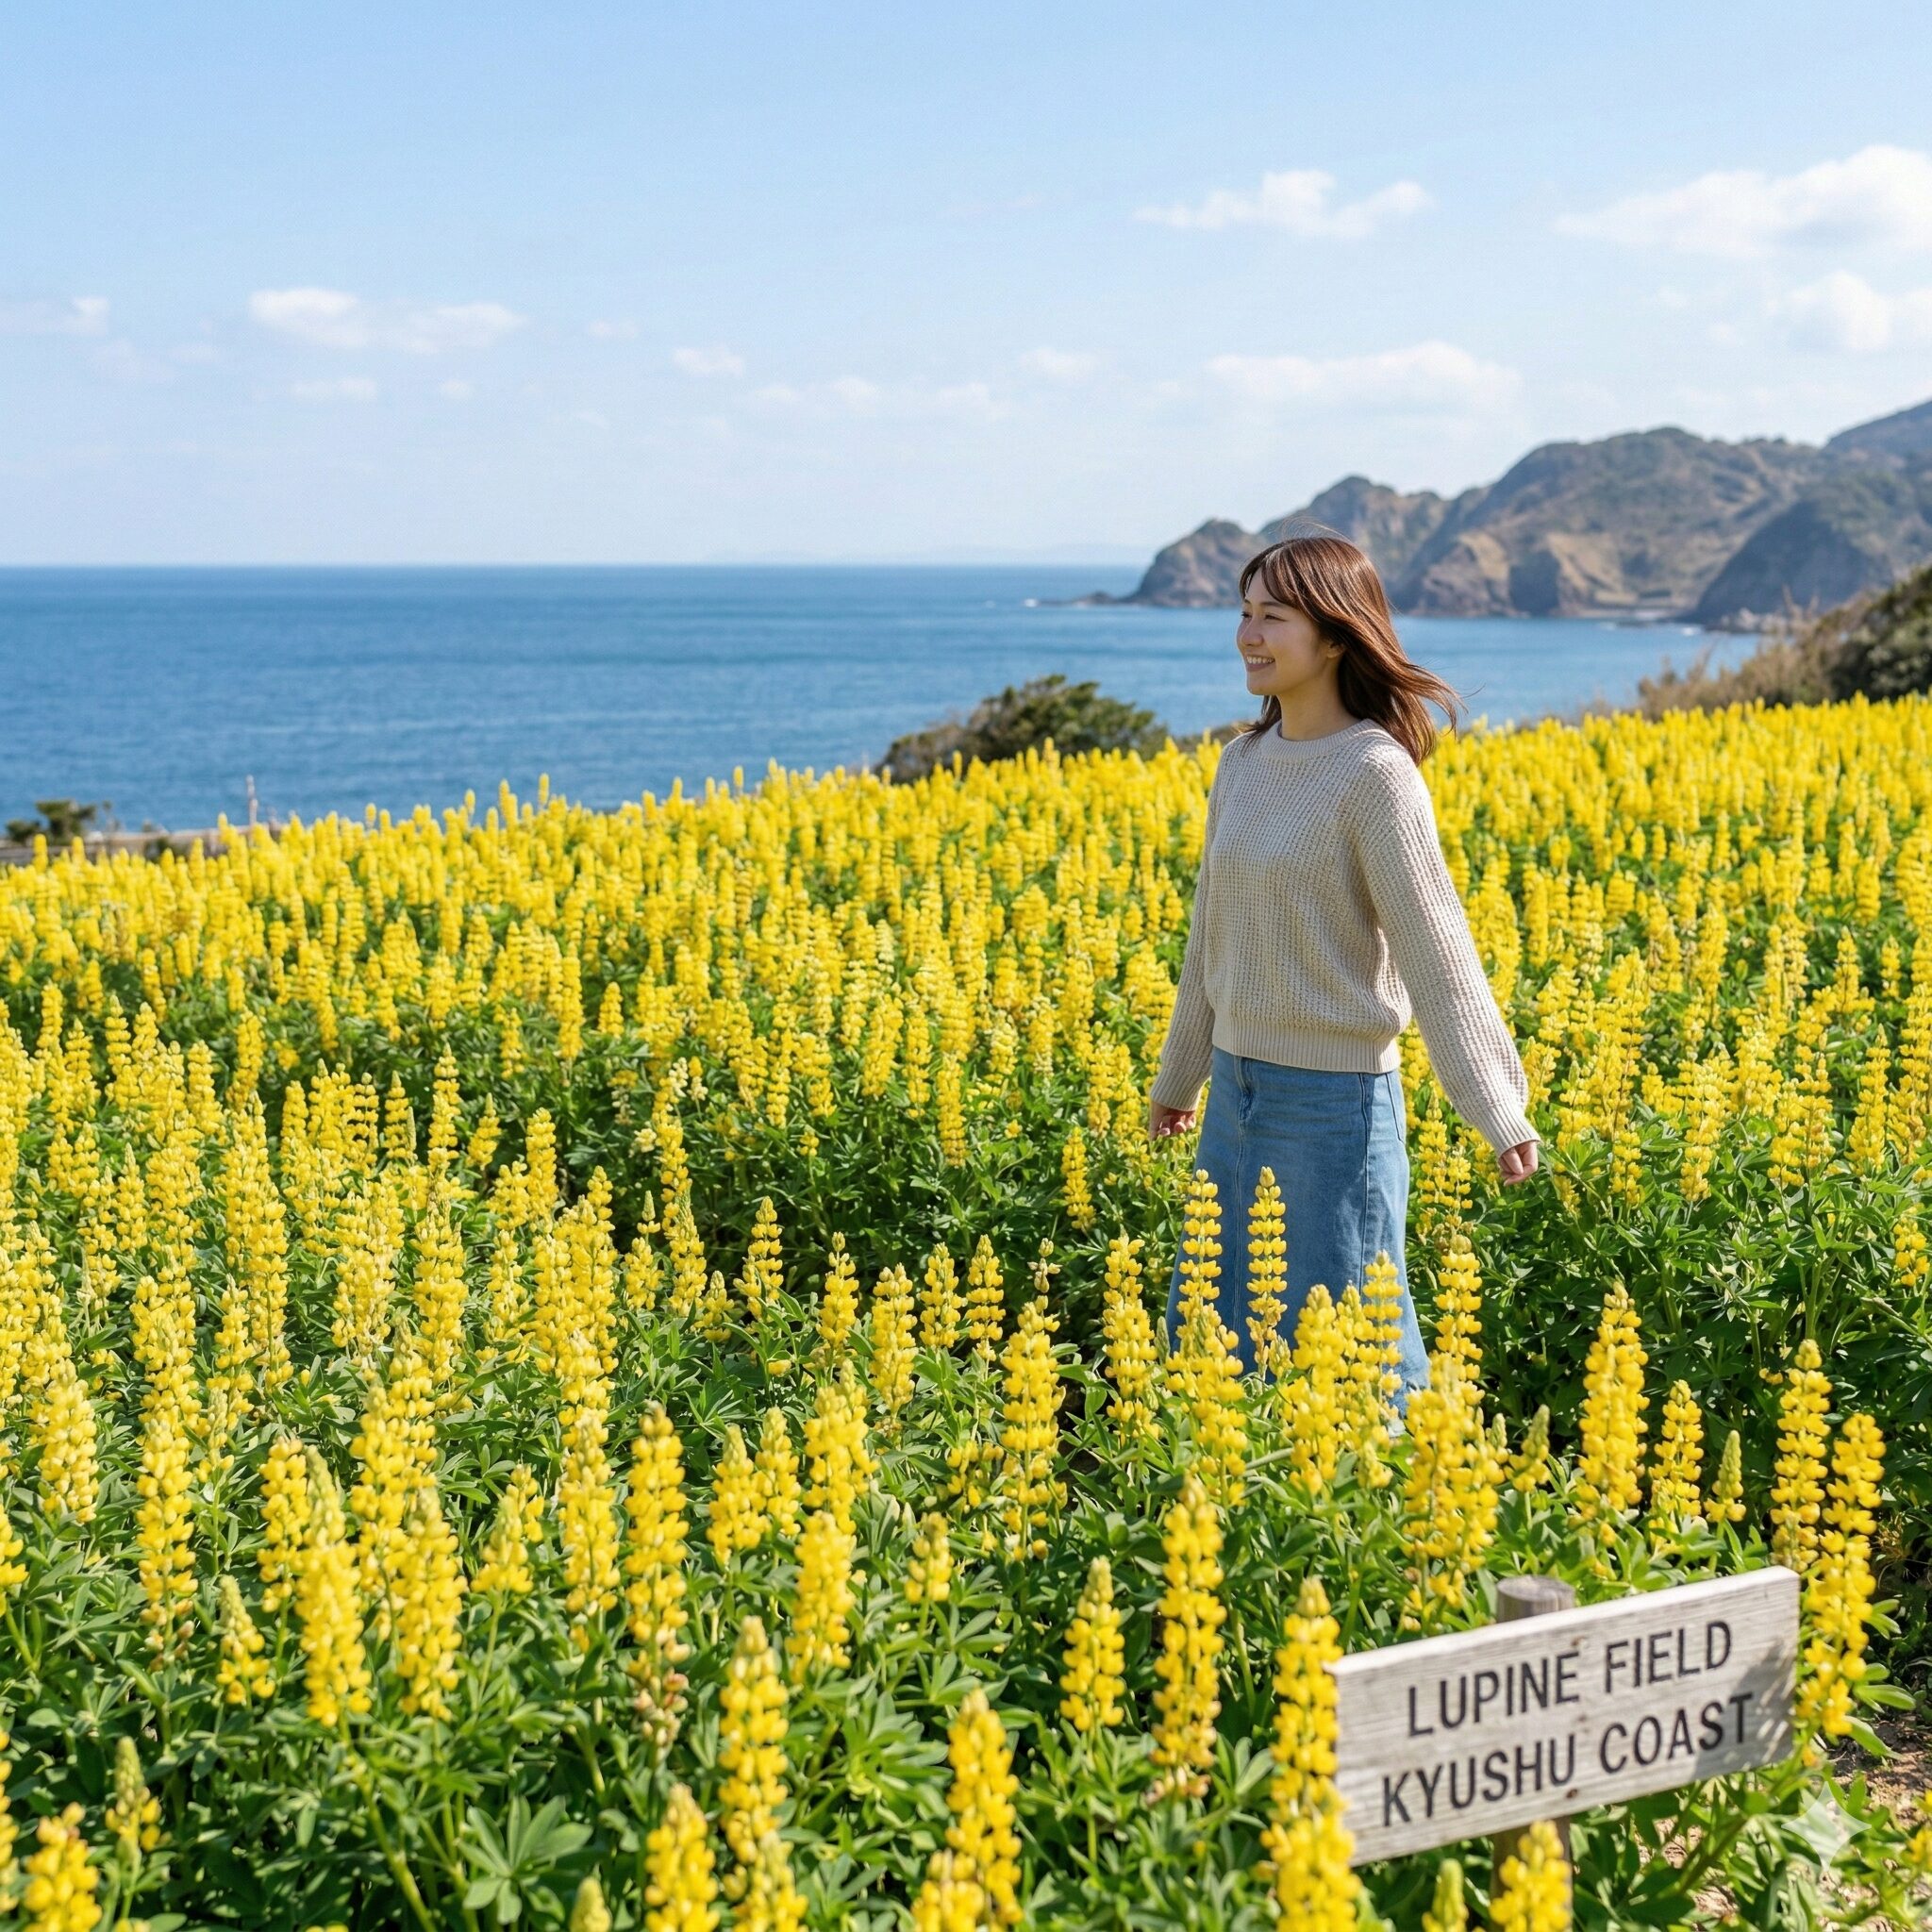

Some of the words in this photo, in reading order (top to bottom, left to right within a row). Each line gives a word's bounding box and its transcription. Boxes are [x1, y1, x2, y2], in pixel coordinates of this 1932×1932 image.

[1408, 1652, 1580, 1737] LUPINE
[1605, 1621, 1732, 1693] FIELD
[1382, 1734, 1576, 1826] KYUSHU
[1600, 1694, 1753, 1774] COAST
